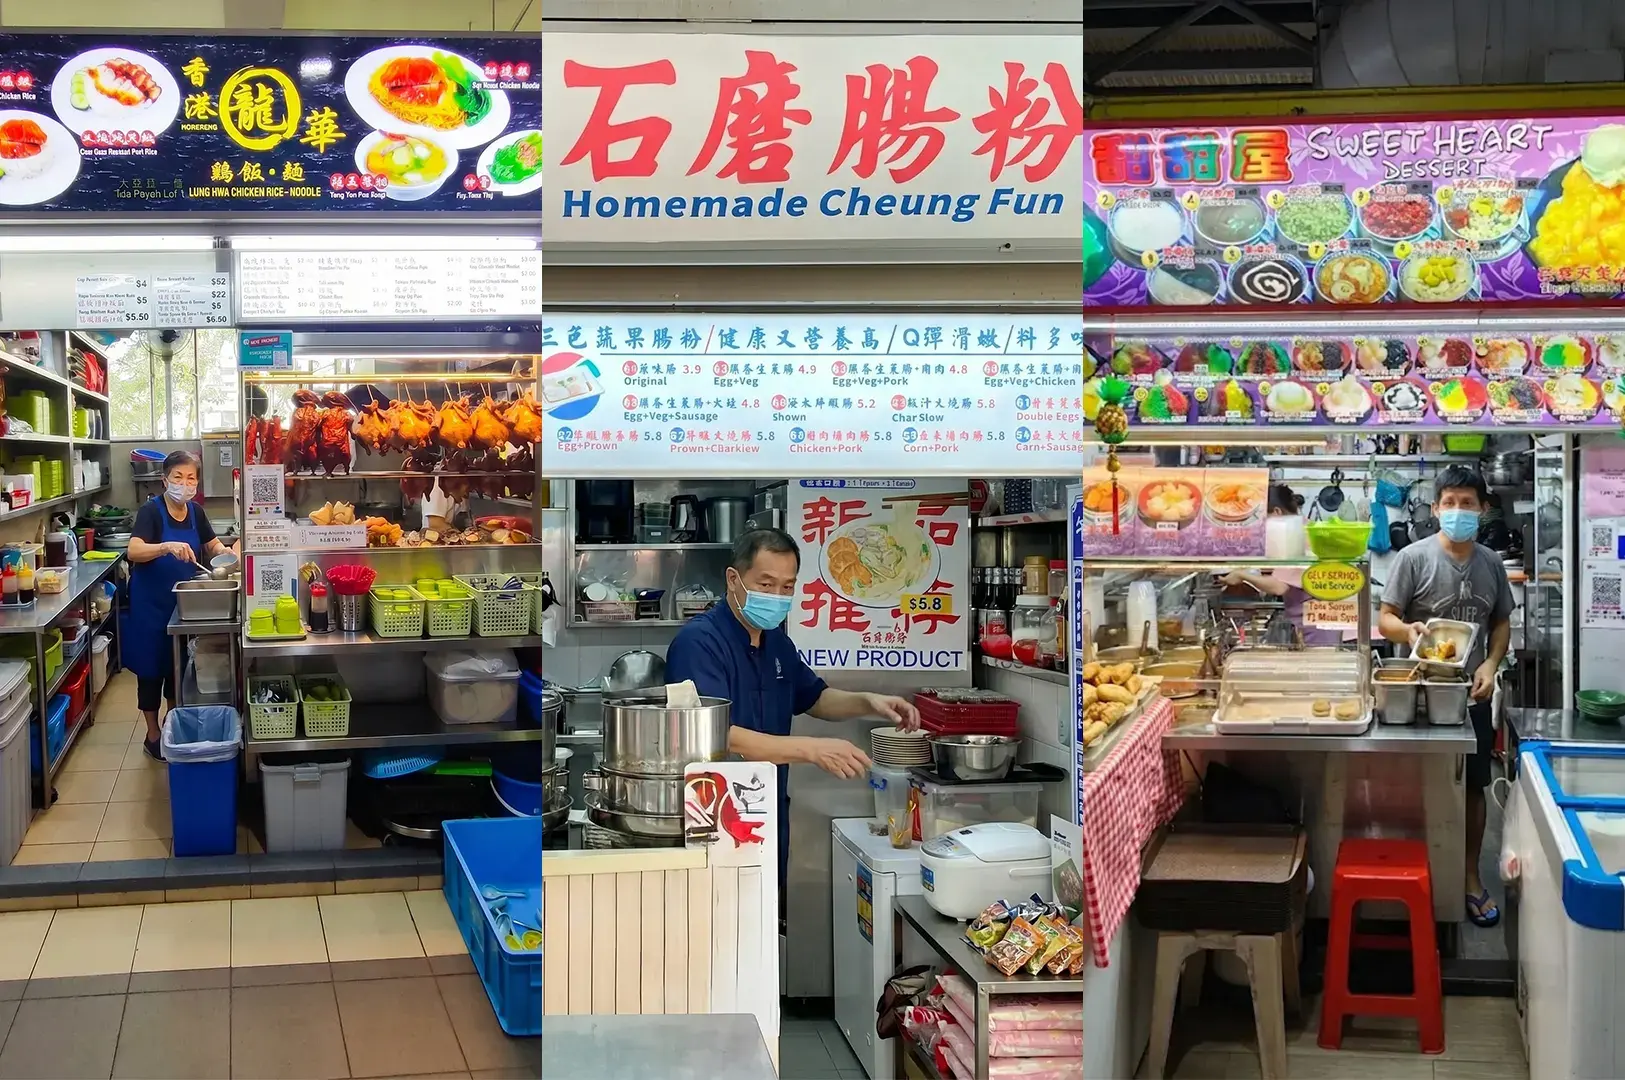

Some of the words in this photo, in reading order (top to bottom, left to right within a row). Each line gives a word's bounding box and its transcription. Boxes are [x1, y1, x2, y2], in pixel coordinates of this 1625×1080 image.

[560, 50, 1083, 184] 石磨腸粉
[1307, 127, 1426, 163] SWEET
[1433, 124, 1553, 157] HEART
[1381, 158, 1488, 181] DESSERT
[189, 187, 210, 197] LUNG
[212, 187, 228, 197] HWA
[231, 187, 265, 197] CHICKEN
[562, 188, 807, 219] Homemade
[819, 187, 980, 222] Cheung
[988, 187, 1065, 215] Fun
[136, 280, 147, 288] $4
[211, 278, 226, 286] $52
[136, 296, 148, 304] $5
[126, 312, 149, 321] $5.50
[206, 316, 227, 324] $6.50
[682, 364, 702, 374] 3.9
[798, 364, 816, 374] 4.9
[949, 364, 968, 374] 4.8
[624, 377, 668, 388] Original
[714, 377, 759, 388] Egg+Veg
[832, 377, 908, 388] Egg+Veg+Pork
[984, 377, 1076, 388] Egg+Veg+Chicken
[741, 398, 760, 408] 4.8
[858, 398, 876, 408] 5.2
[977, 398, 996, 408] 5.8
[624, 412, 718, 422] Egg+Veg+Sausage
[772, 412, 806, 421] Shown
[892, 414, 917, 422] Char
[919, 413, 944, 422] Slow
[1016, 412, 1053, 420] Double
[1056, 412, 1080, 422] Eegs
[644, 432, 662, 440] 5.8
[756, 432, 775, 440] 5.8
[874, 432, 892, 440] 5.8
[986, 431, 1005, 440] 5.8
[558, 442, 618, 452] Egg+Prown
[790, 444, 863, 452] Chicken+Pork
[904, 444, 959, 452] Corn+Pork
[909, 598, 942, 610] $5.8
[799, 650, 850, 667] NEW
[856, 650, 963, 668] PRODUCT
